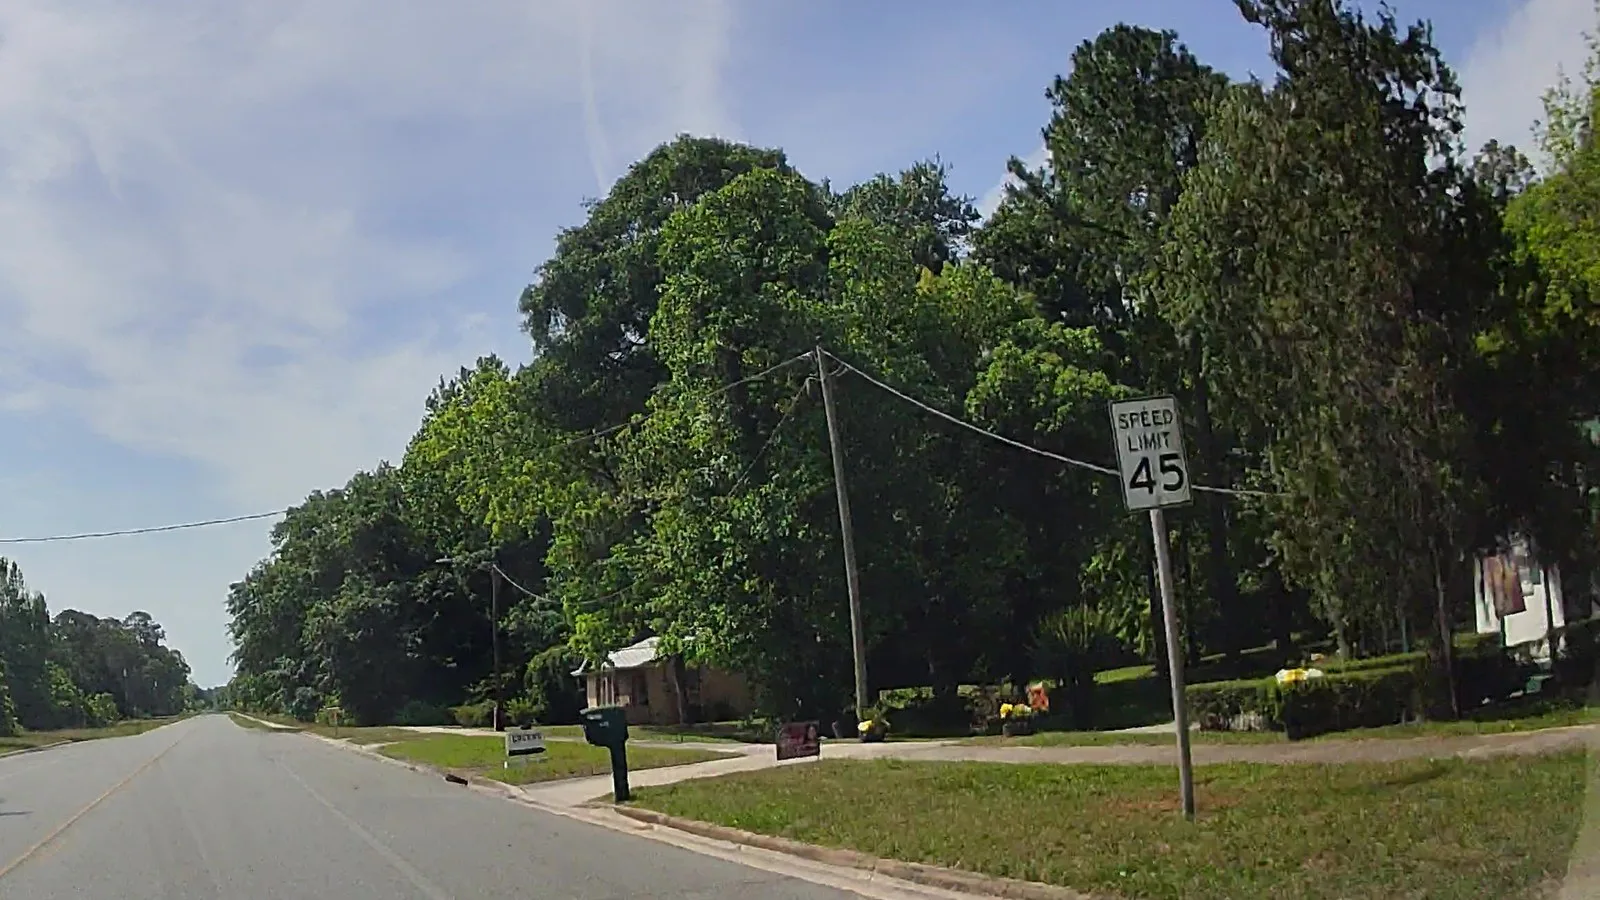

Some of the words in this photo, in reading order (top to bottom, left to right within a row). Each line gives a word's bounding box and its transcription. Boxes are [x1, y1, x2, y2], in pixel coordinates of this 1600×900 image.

[1118, 409, 1173, 430] SPEED
[1127, 432, 1170, 452] LIMIT
[1129, 453, 1184, 495] 45
